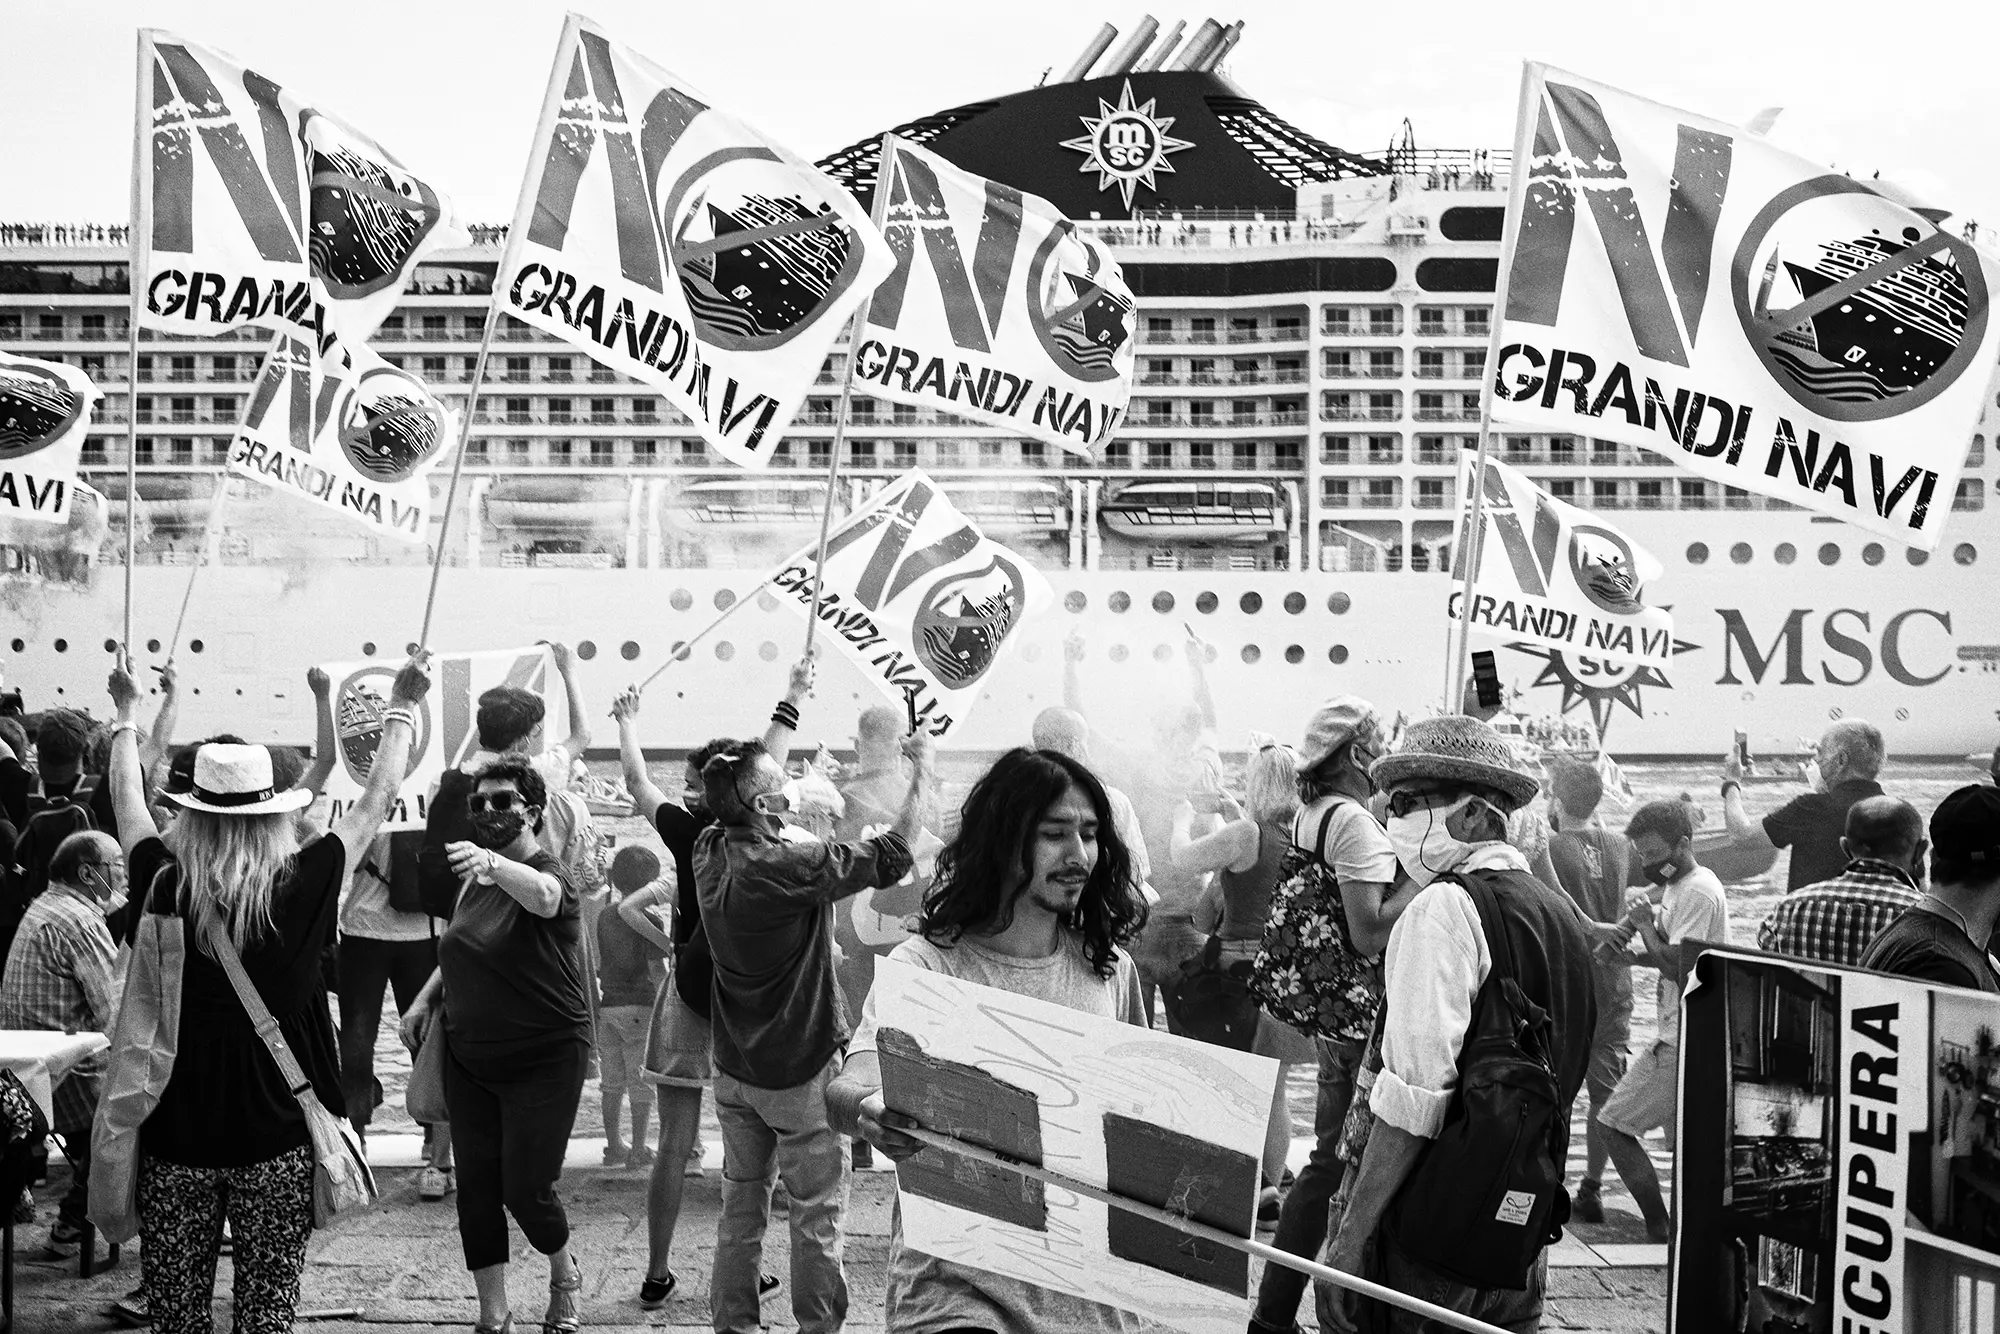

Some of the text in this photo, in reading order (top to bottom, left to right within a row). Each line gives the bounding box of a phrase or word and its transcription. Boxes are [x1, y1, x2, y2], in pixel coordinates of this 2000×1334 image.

[509, 263, 690, 381] GRANDI
[856, 340, 1033, 417] GRANDI
[1496, 343, 1938, 529] GRANDI NAVI
[0, 472, 64, 513] AVI
[231, 436, 420, 533] GRANDI NAVI
[1448, 591, 1669, 658] GRANDI NAVI
[1714, 608, 1952, 687] MSC
